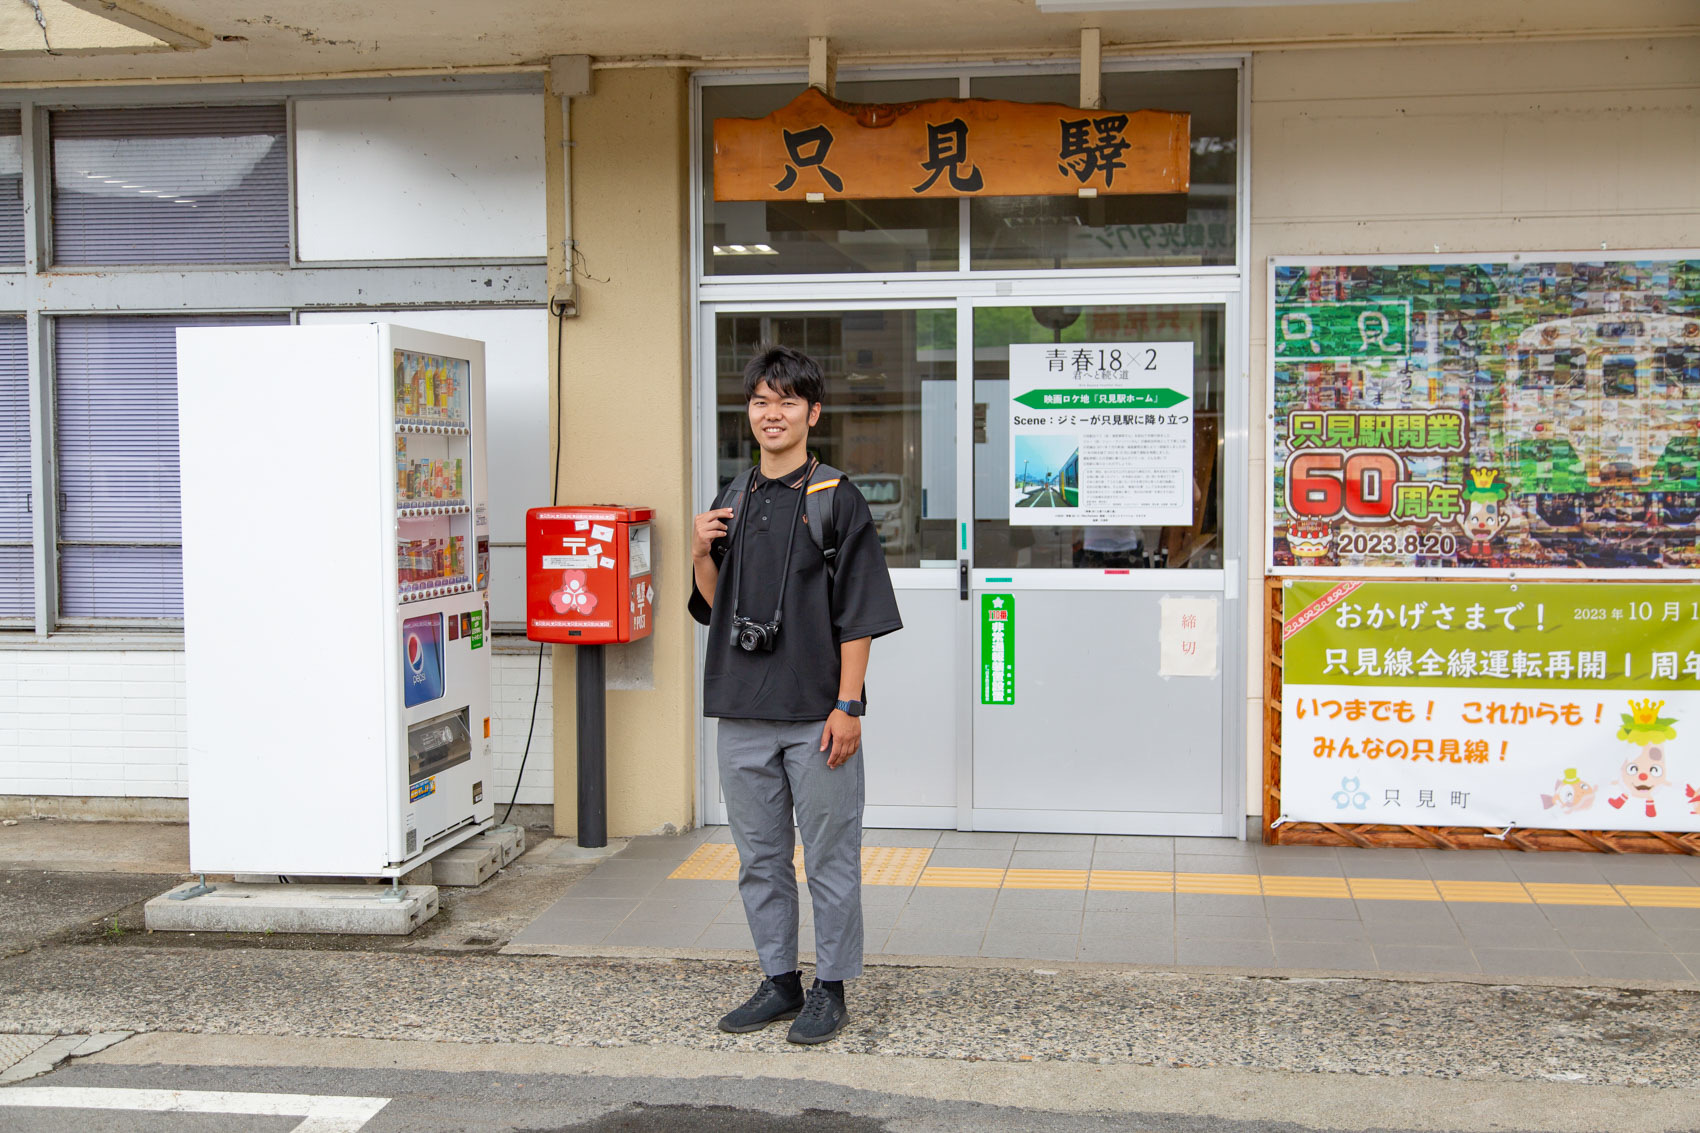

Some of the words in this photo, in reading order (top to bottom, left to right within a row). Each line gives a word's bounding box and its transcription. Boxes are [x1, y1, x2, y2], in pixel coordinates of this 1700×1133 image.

[771, 112, 1131, 193] 只見驛
[1276, 311, 1403, 354] 只見
[1074, 370, 1129, 380] 君へと続く道
[1043, 393, 1159, 404] 映画ロケ地『只見駅ホーム』
[1291, 413, 1463, 450] 只見駅開業
[1338, 533, 1456, 555] 2023.8.20
[1335, 602, 1545, 632] おかげさまで！
[1181, 613, 1197, 656] 締切
[1295, 697, 1437, 723] いつまでも！
[1461, 702, 1604, 726] これからも！
[1312, 736, 1510, 763] みんなの只見線！
[1383, 788, 1471, 809] 只見町
